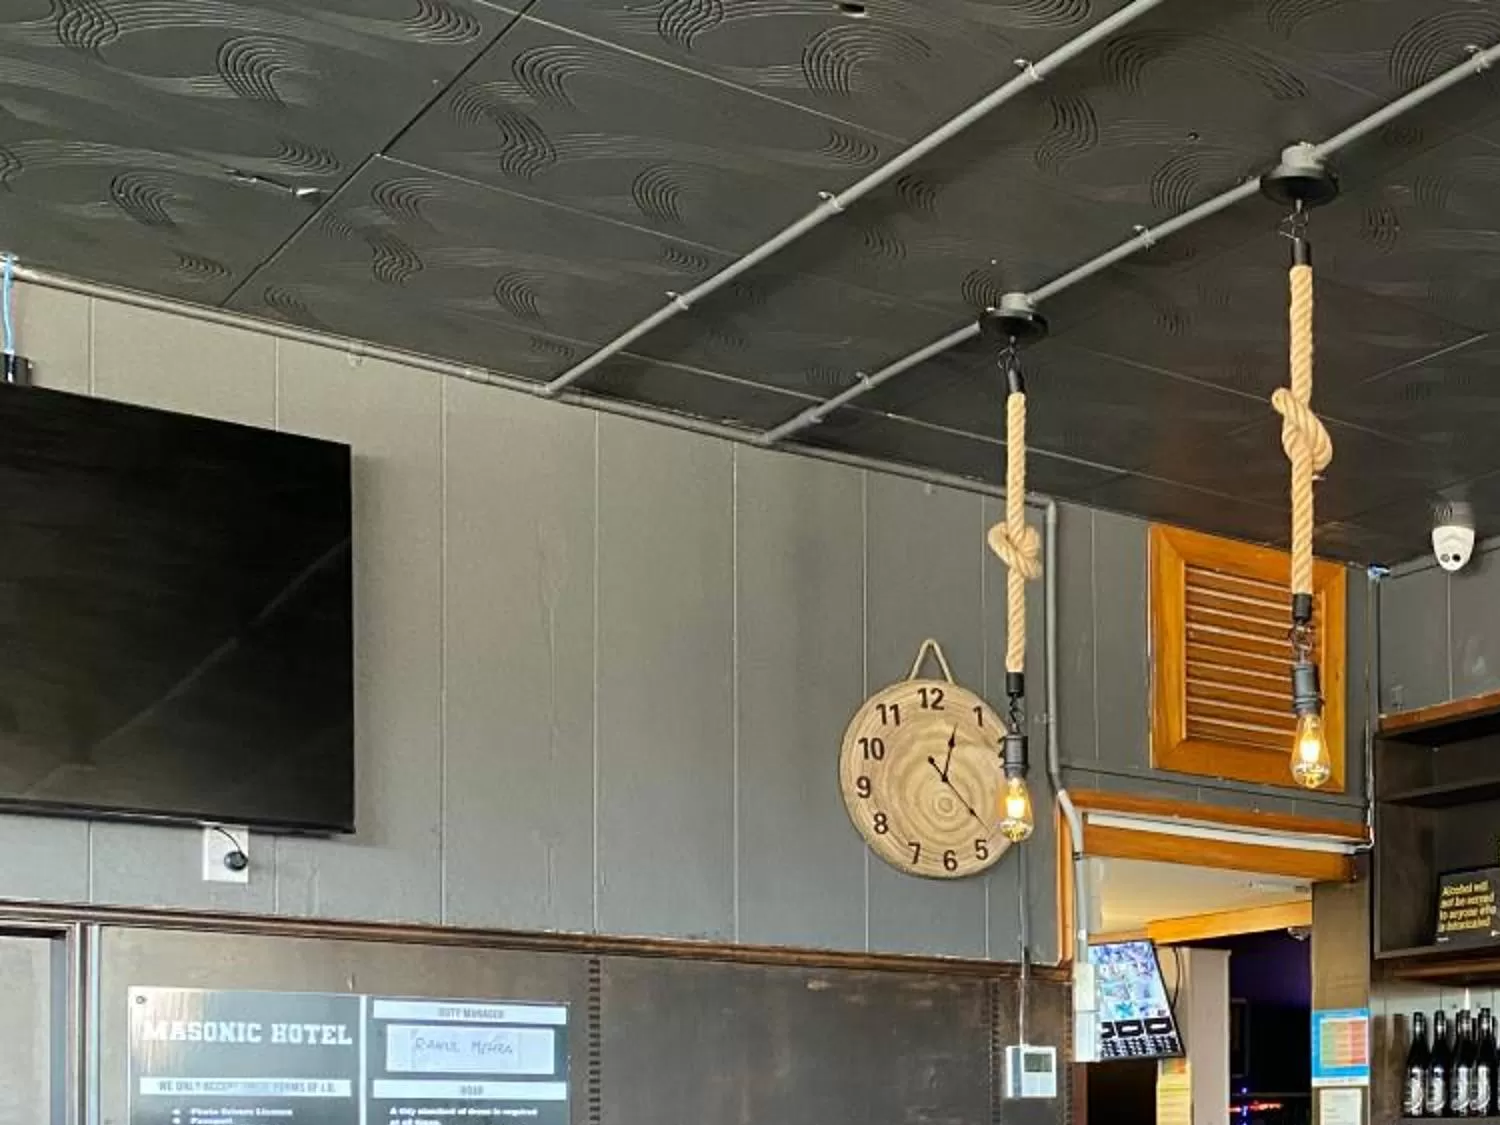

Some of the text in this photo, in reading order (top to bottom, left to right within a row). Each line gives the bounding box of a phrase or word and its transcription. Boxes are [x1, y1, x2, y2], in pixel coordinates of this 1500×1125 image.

[917, 688, 945, 711] 12
[876, 703, 901, 726] 11
[973, 706, 984, 727] 1
[858, 737, 885, 760] 10
[856, 776, 871, 798] 9
[873, 812, 889, 834] 8
[908, 842, 921, 864] 7
[943, 850, 959, 871] 6
[974, 839, 989, 861] 5
[142, 1020, 353, 1045] MASONIC HOTEL
